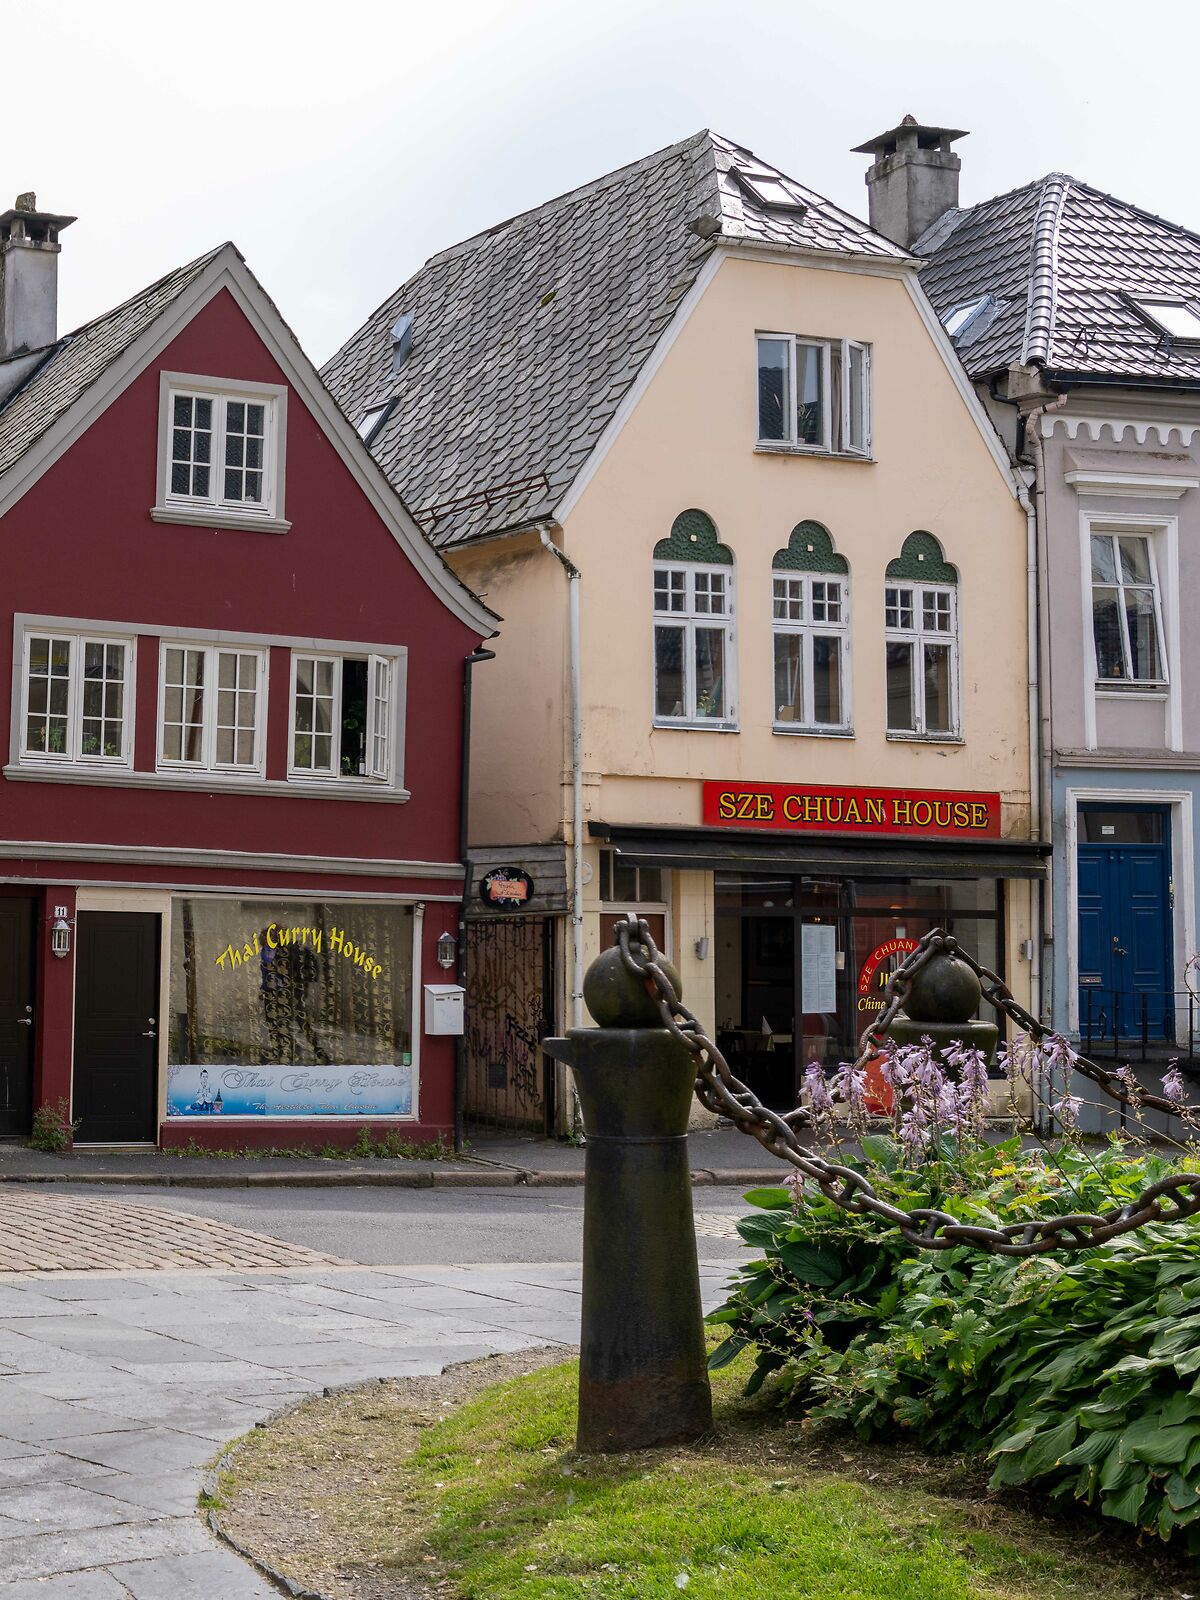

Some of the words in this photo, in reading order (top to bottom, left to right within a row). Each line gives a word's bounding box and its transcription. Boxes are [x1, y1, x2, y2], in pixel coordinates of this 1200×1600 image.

[719, 792, 774, 821] SZE
[782, 795, 884, 824] CHUAN
[892, 799, 989, 829] HOUSE
[58, 908, 65, 916] 11
[215, 932, 261, 971] Thai
[266, 923, 322, 953] Curry
[330, 927, 383, 980] House
[860, 966, 873, 991] SZE
[874, 941, 913, 960] CHUAN
[858, 997, 886, 1011] Chine
[221, 1068, 273, 1089] Thai
[280, 1072, 342, 1093] Curry
[348, 1071, 407, 1095] House
